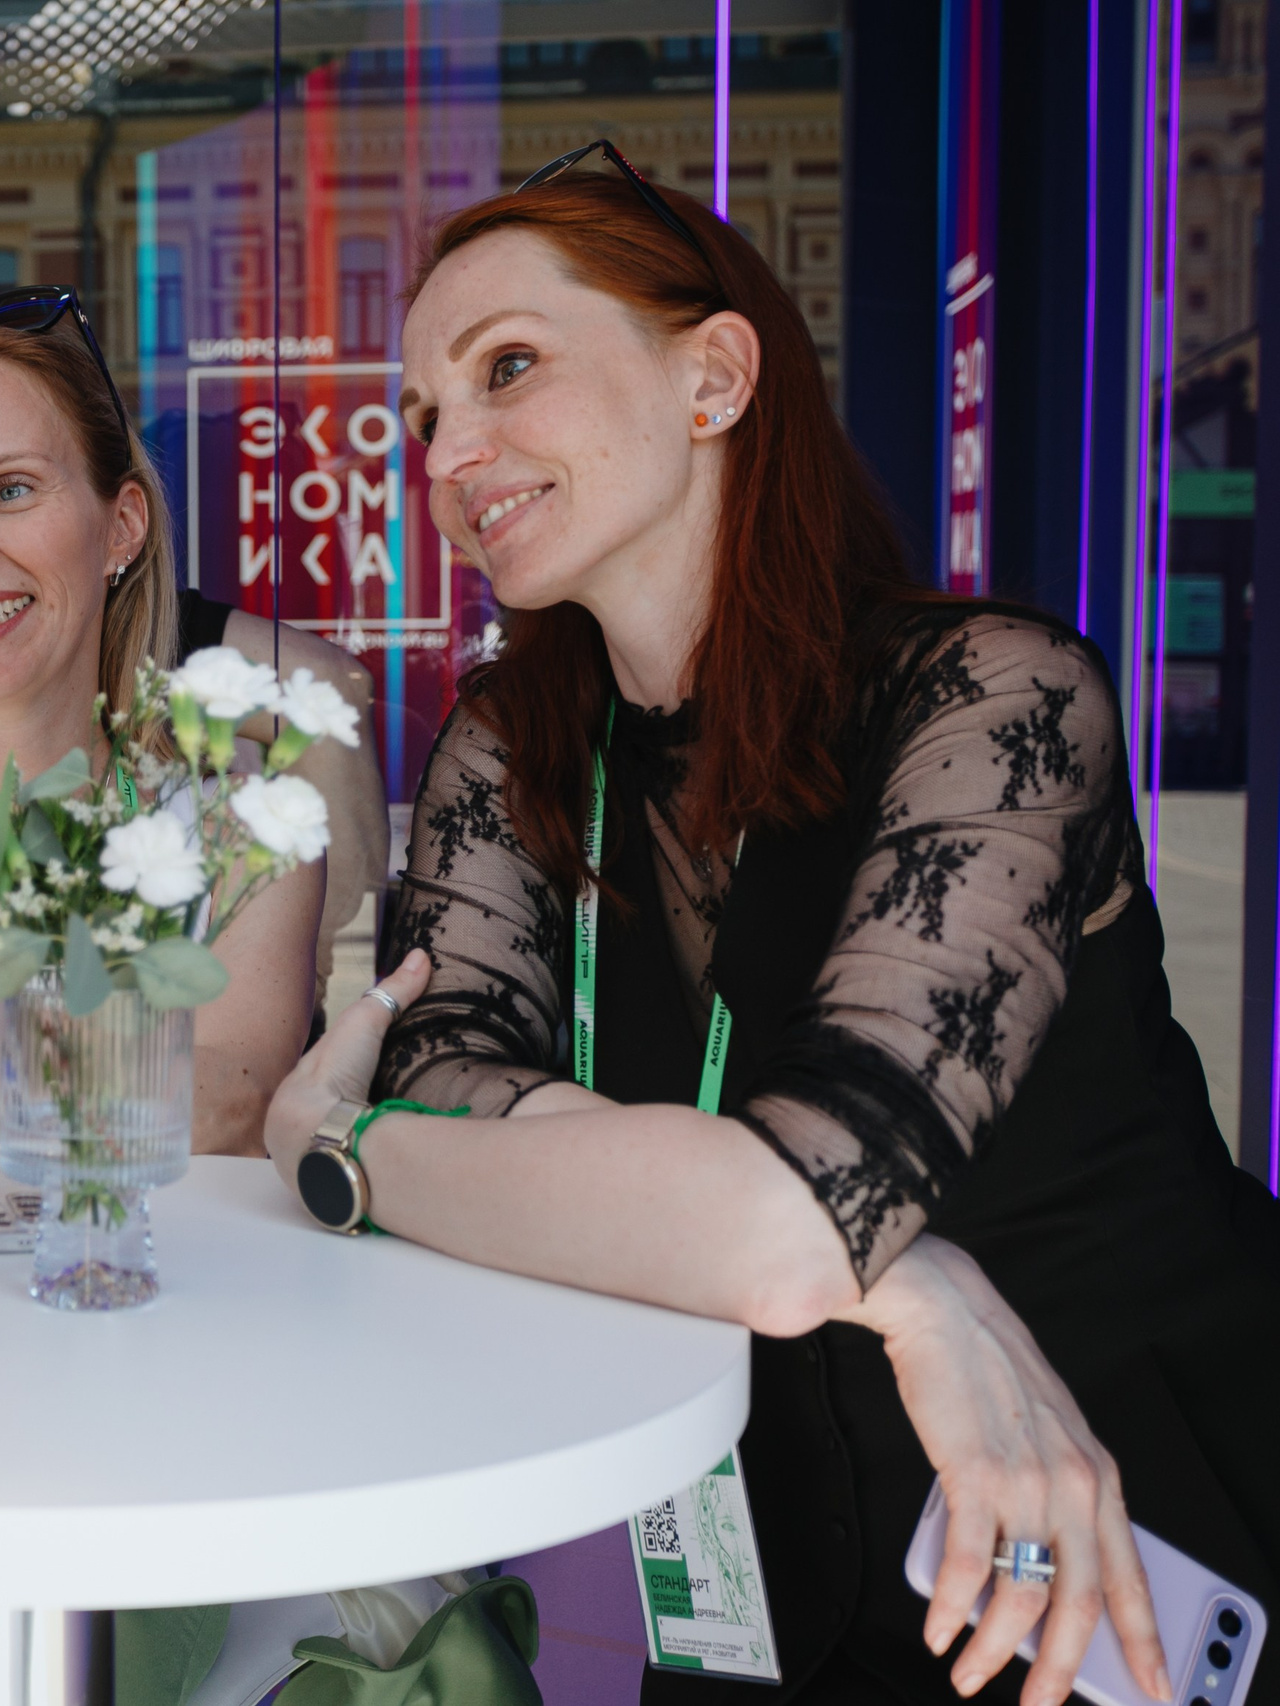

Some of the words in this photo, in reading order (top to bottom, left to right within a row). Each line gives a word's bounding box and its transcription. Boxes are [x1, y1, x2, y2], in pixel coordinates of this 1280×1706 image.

[239, 469, 400, 523] НОМ
[650, 1574, 710, 1593] СТАНДАРТ
[654, 1604, 686, 1615] НАДЕЖДА
[688, 1607, 726, 1618] АНДРЕЕВНА
